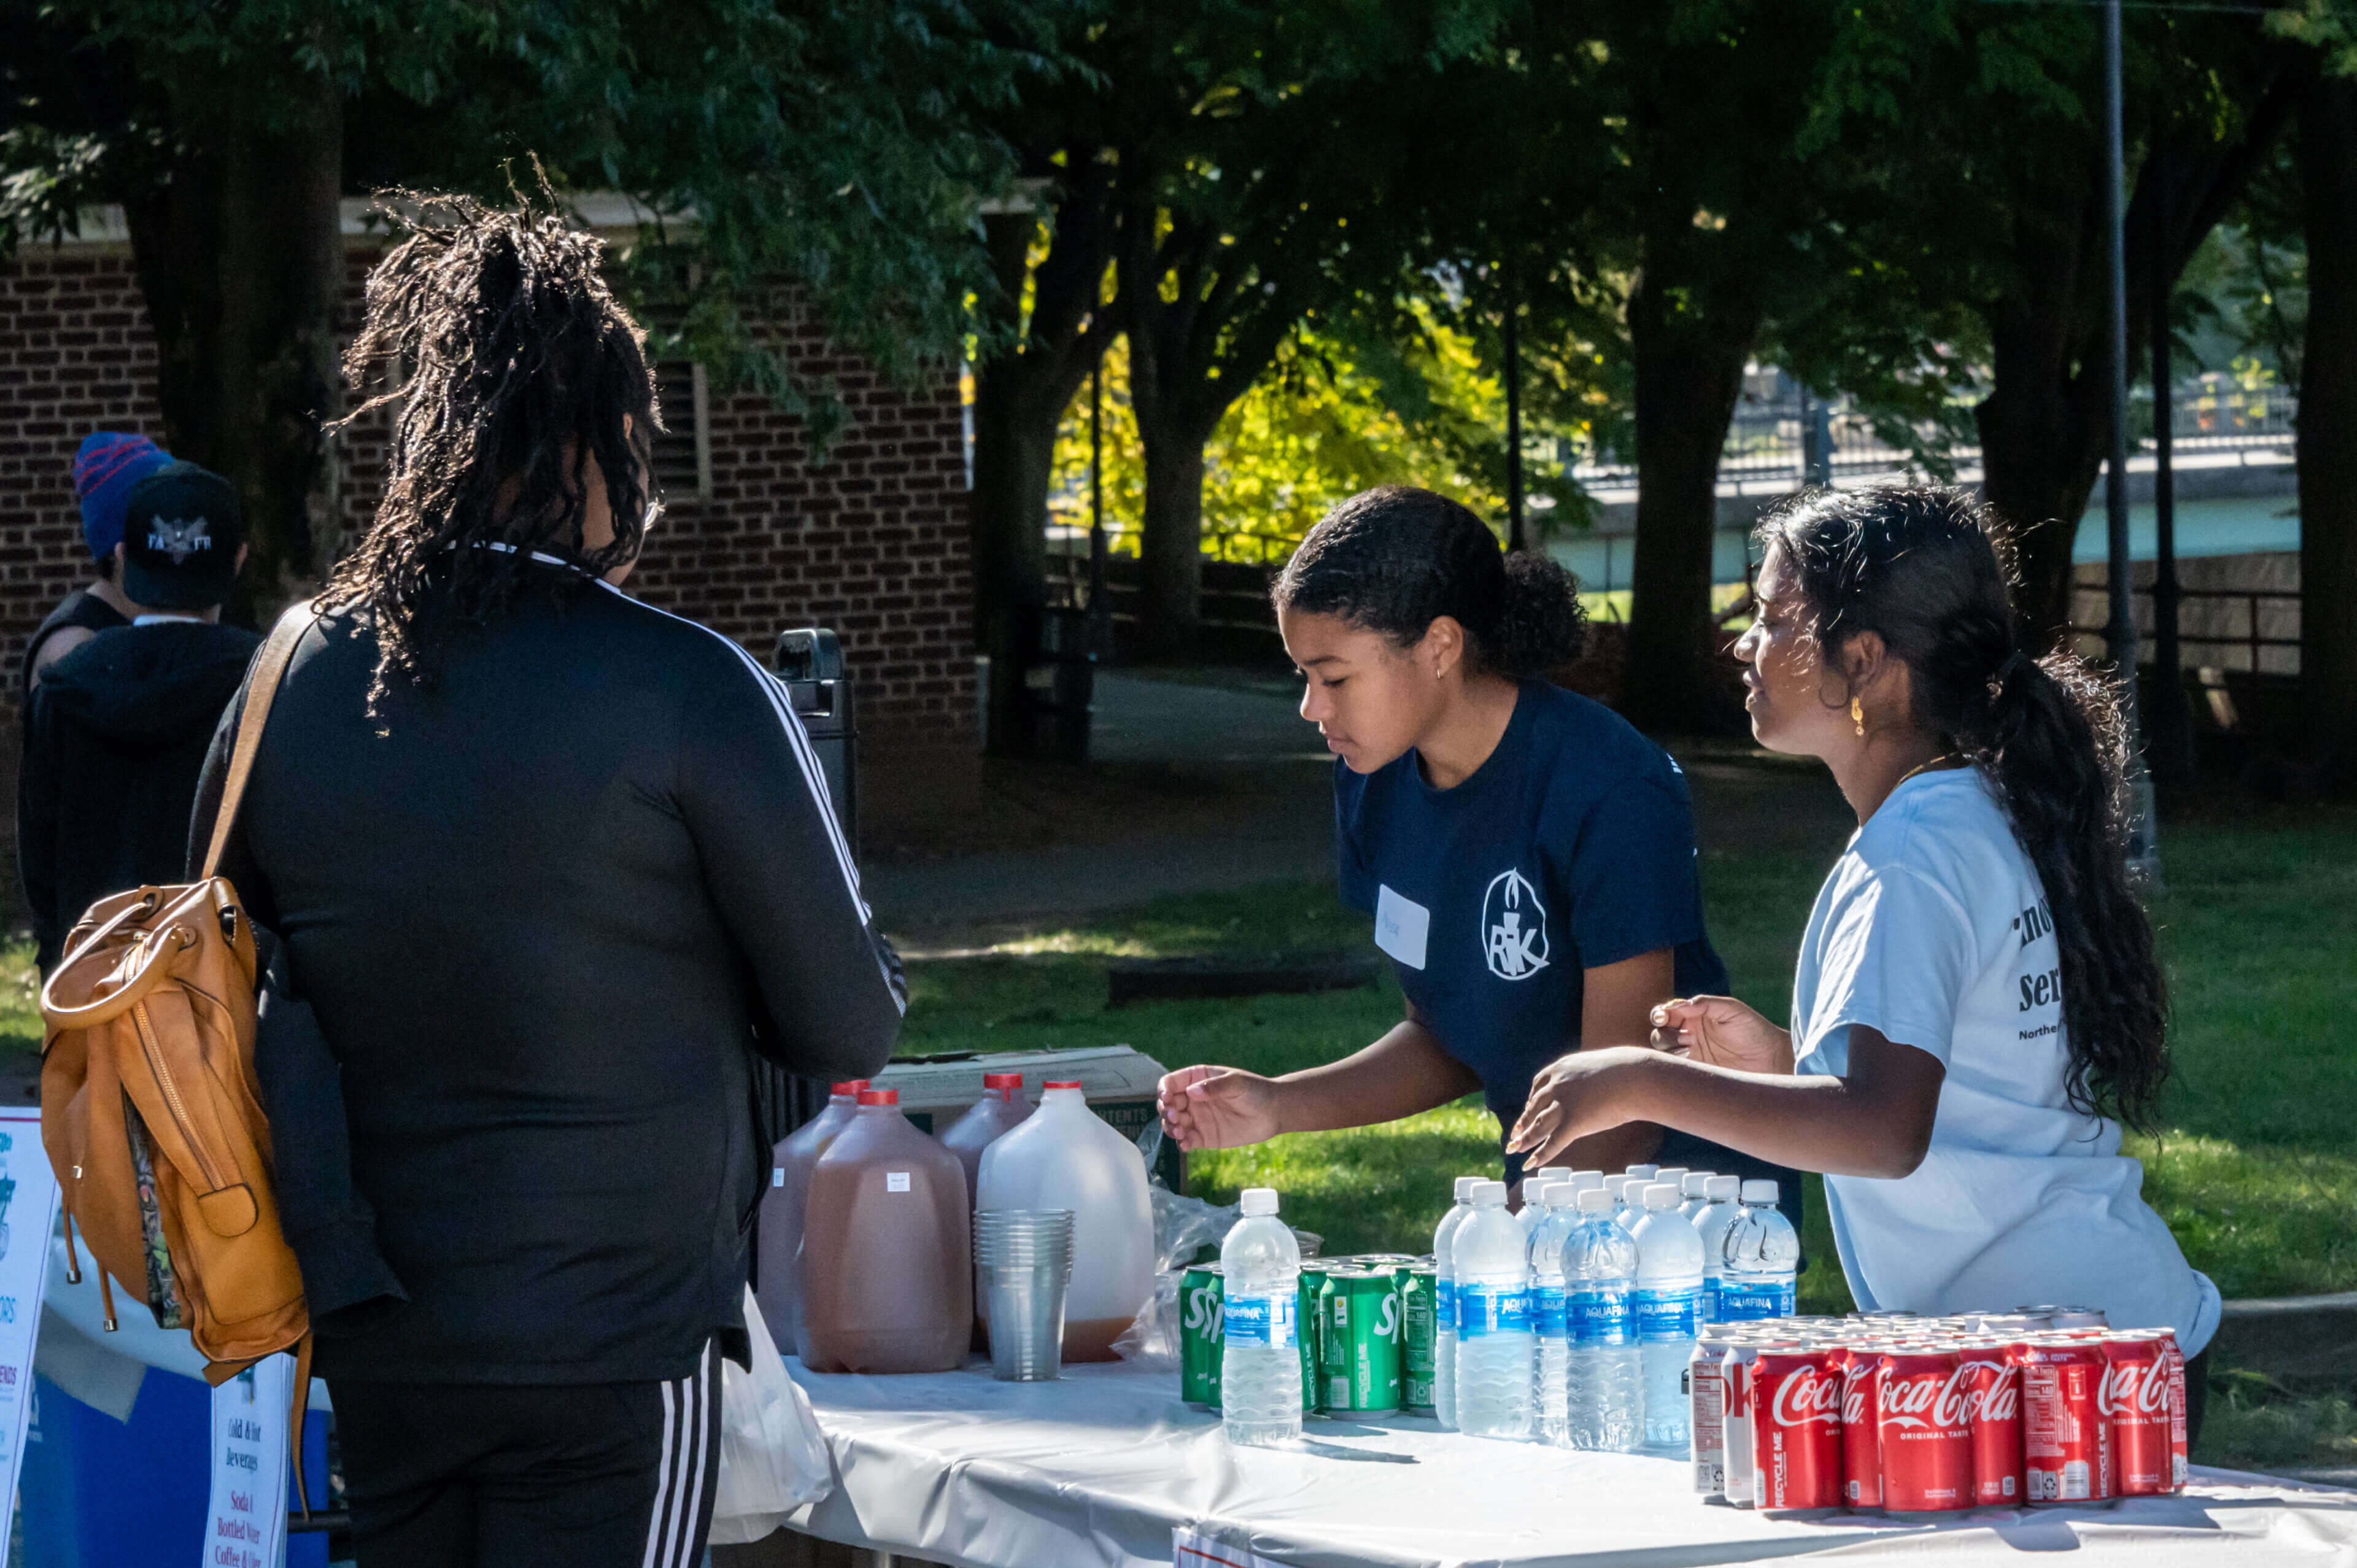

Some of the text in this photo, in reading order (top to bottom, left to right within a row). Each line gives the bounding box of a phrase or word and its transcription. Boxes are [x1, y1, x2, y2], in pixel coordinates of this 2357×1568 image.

[1585, 1305, 1630, 1319] AQUAFINA
[1640, 1302, 1684, 1316] AQUAFINA
[1728, 1296, 1772, 1310] AQUAFINA
[1900, 1431, 1945, 1440] ORIGINAL
[1773, 1432, 1785, 1507] RECYCLE ME
[2098, 1421, 2108, 1497] RECYCLE ME
[231, 1490, 249, 1512] Soda
[217, 1517, 246, 1540] Bottled
[215, 1545, 240, 1567] Coffee
